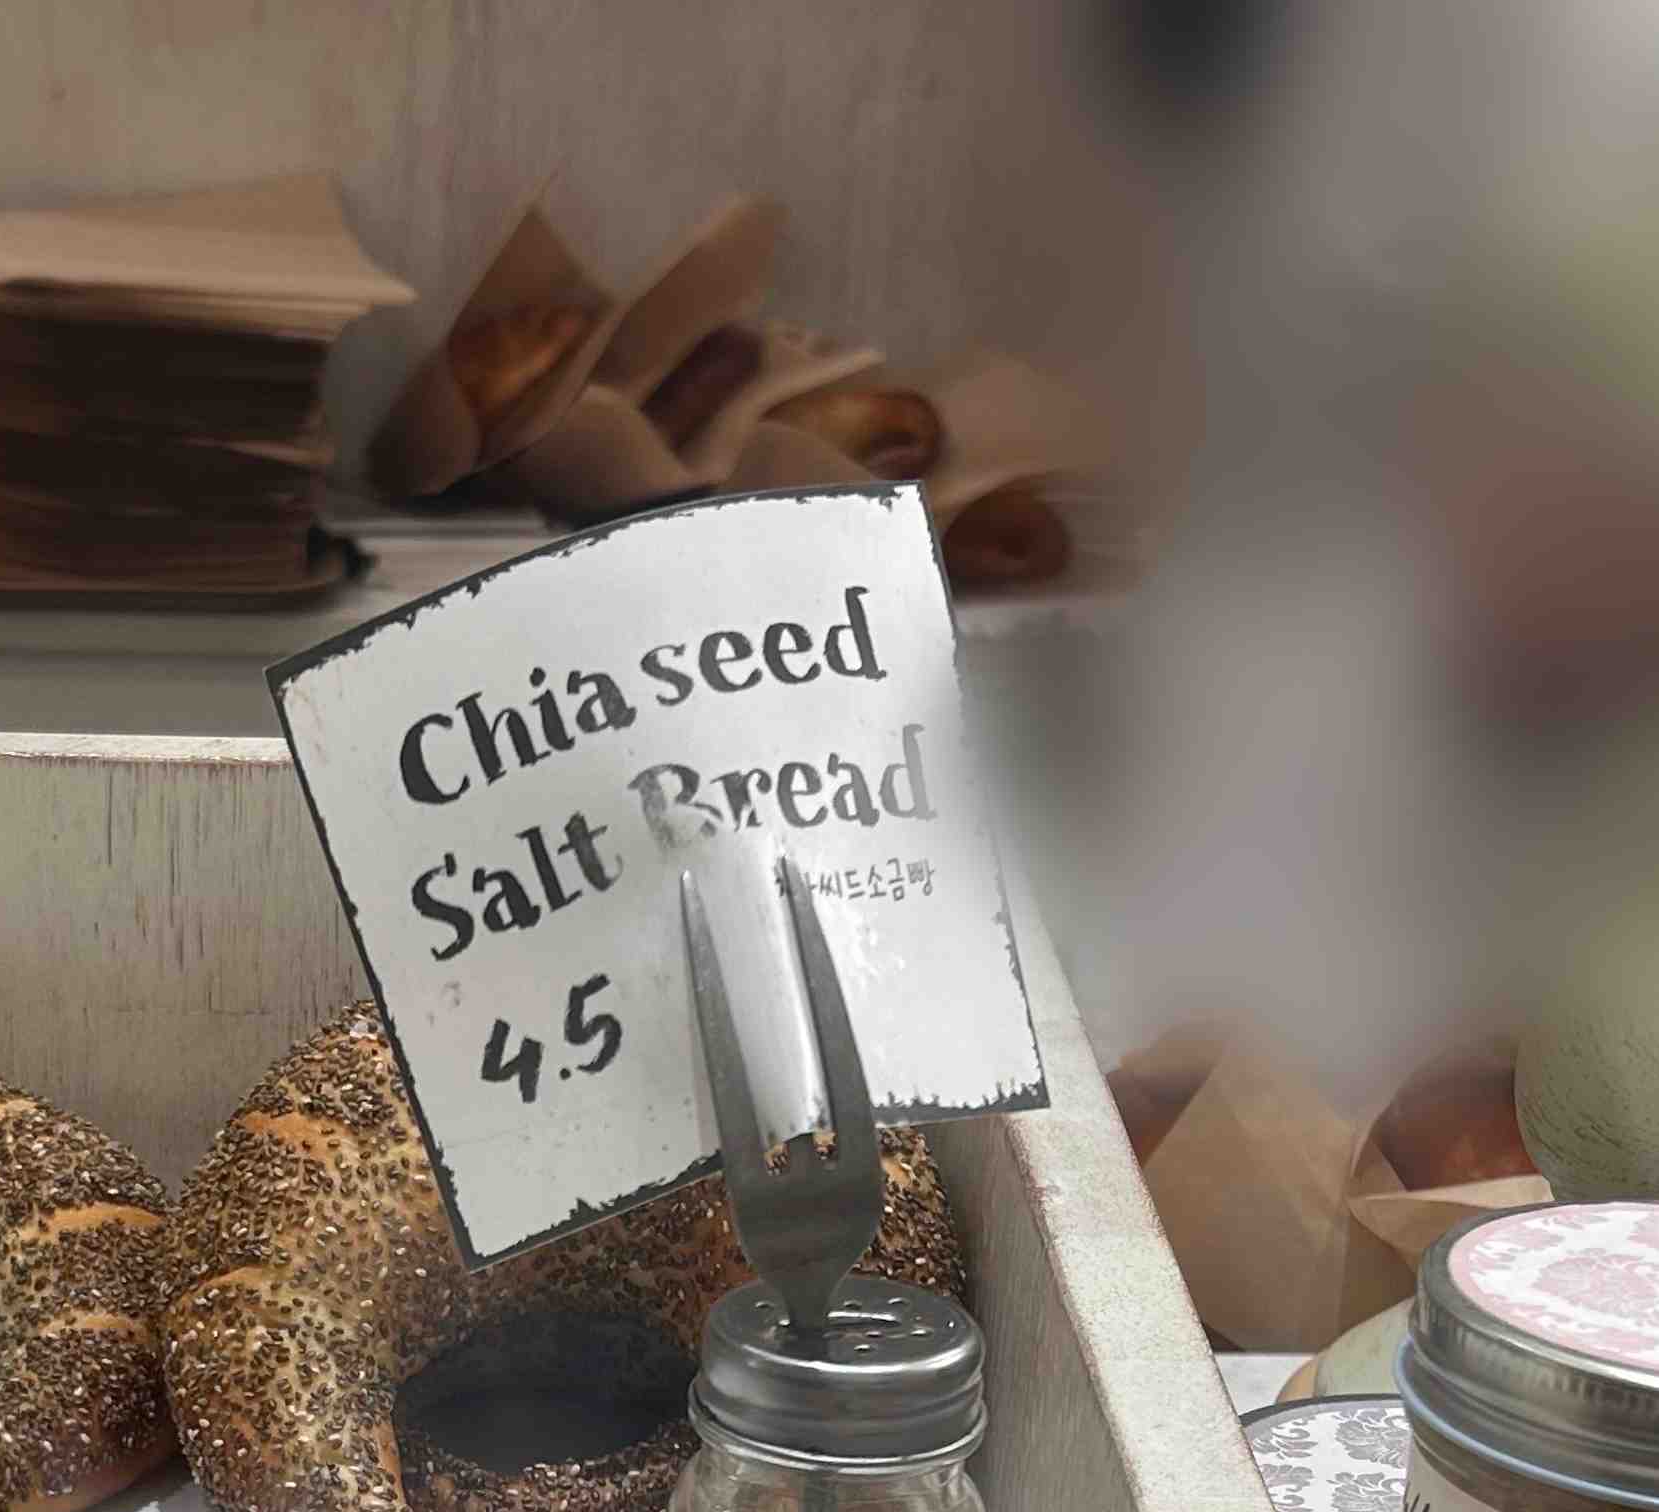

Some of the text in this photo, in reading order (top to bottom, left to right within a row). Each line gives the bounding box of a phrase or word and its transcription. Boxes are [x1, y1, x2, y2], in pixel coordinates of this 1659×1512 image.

[411, 723, 938, 962] Salt Bread
[774, 857, 936, 902] 씨드소금빵
[480, 973, 623, 1104] 4.5
